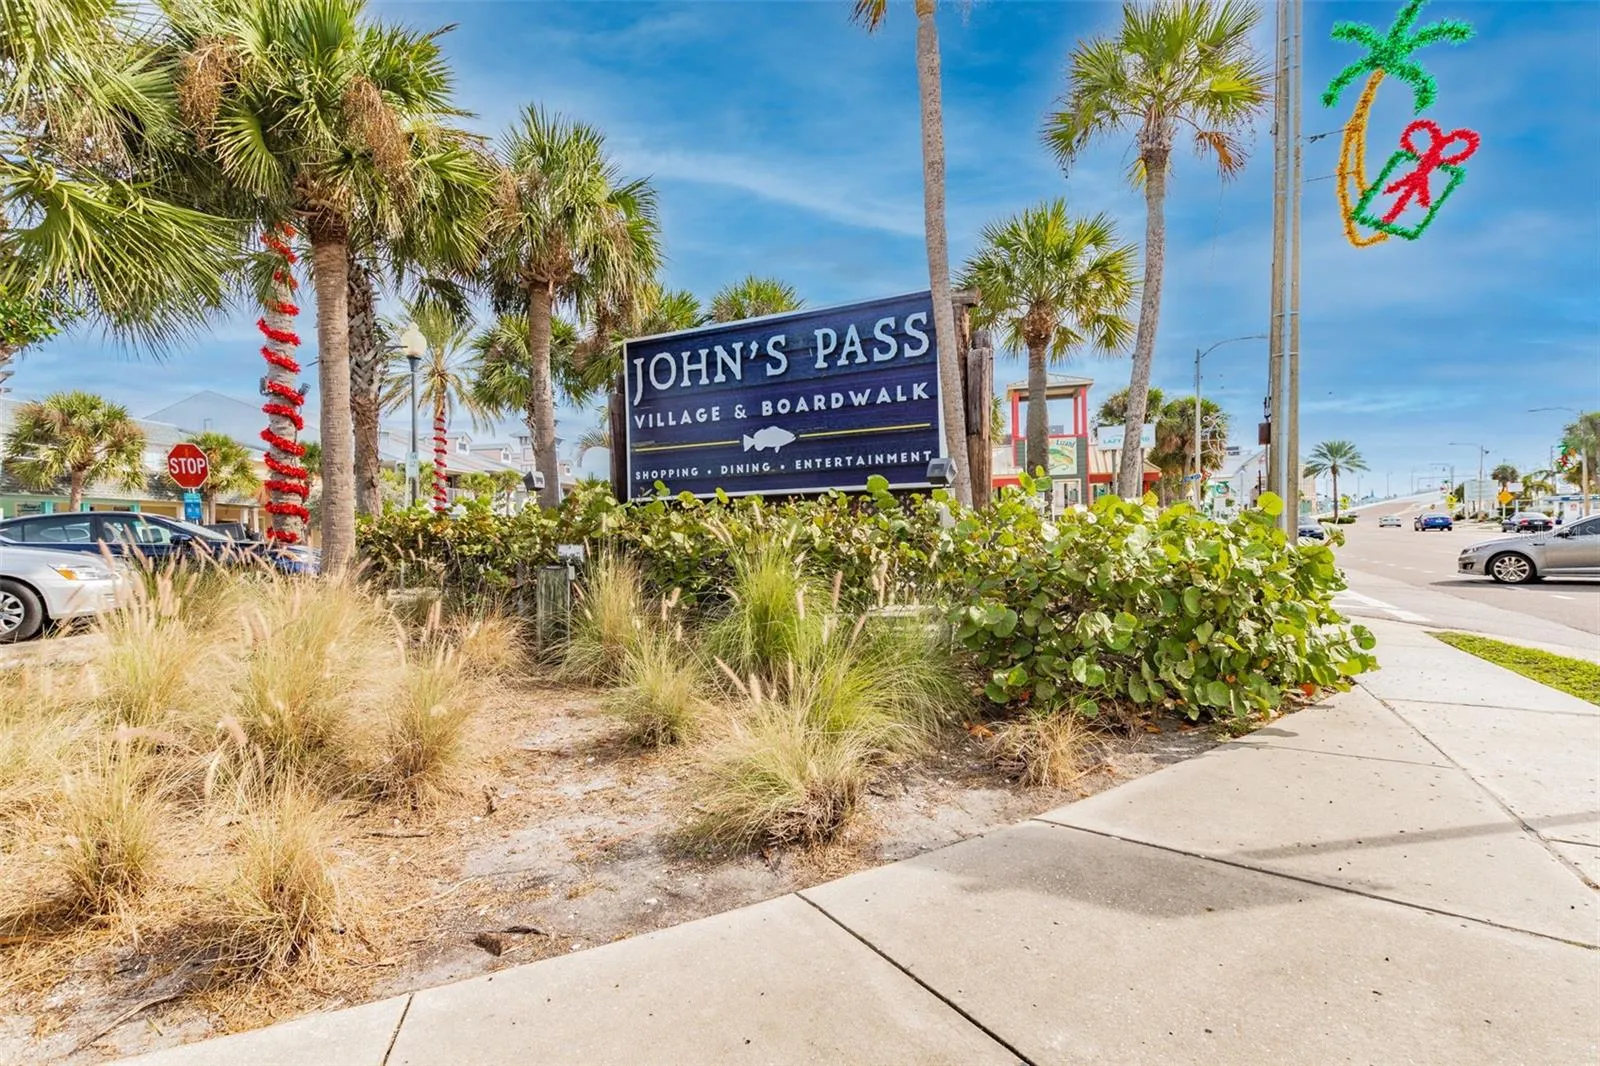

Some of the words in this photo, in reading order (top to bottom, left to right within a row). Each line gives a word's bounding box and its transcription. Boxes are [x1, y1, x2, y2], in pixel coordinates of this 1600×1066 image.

[633, 334, 788, 406] JOHN'S
[814, 311, 930, 369] PASS
[634, 406, 721, 429] VILLAGE
[734, 404, 748, 419] &
[762, 382, 930, 416] BOARDWALK
[169, 457, 206, 475] STOP
[635, 467, 699, 480] SHOPPING
[721, 462, 770, 475] DINING
[795, 450, 932, 470] ENTERTAINMENT
